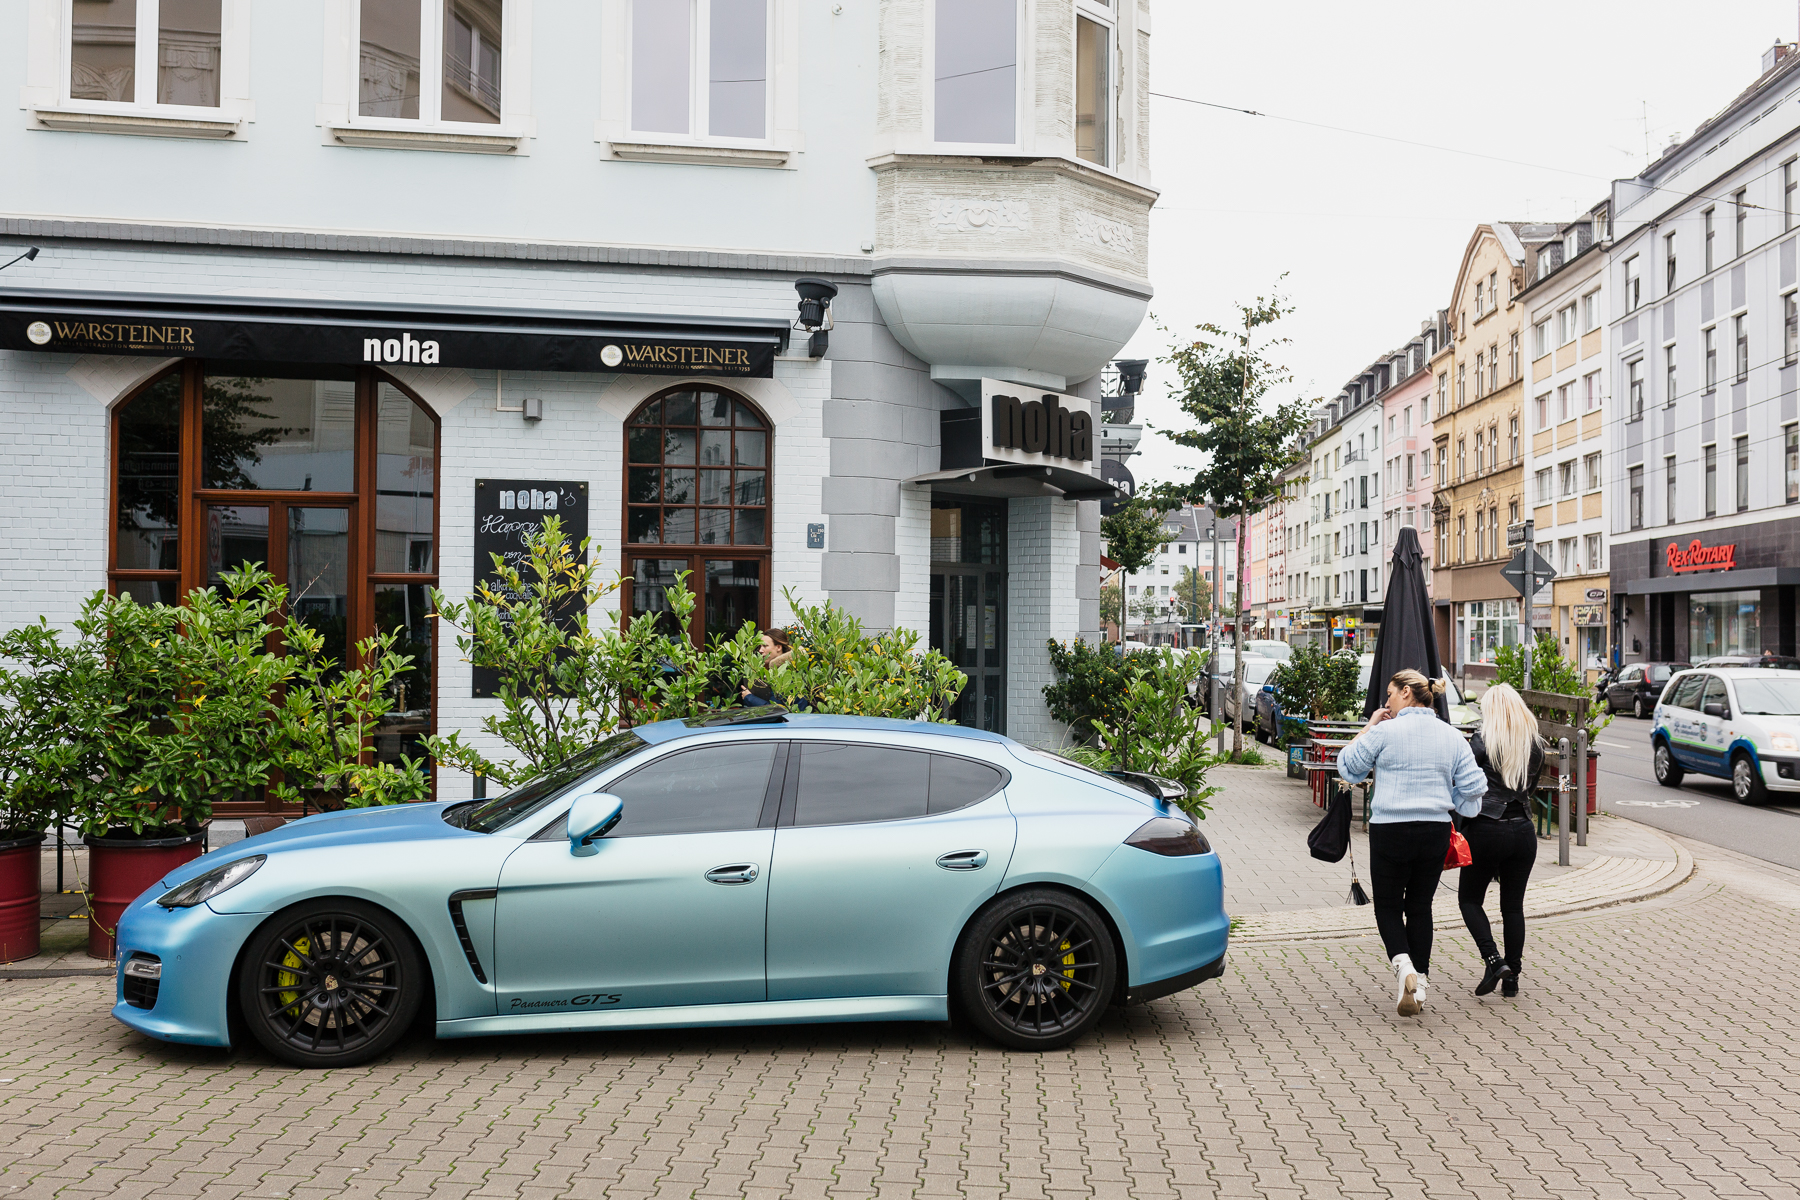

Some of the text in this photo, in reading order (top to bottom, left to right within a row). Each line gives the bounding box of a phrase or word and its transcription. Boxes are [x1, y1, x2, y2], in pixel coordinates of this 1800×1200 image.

[54, 321, 194, 344] WARSTEINER
[363, 332, 440, 364] noha
[624, 344, 750, 365] WARSTEINER
[622, 362, 690, 370] FAMILIENTRADITION
[992, 394, 1093, 462] noha
[499, 486, 577, 510] noha's
[480, 514, 539, 540] Happy
[510, 993, 622, 1010] Panamera GTS
